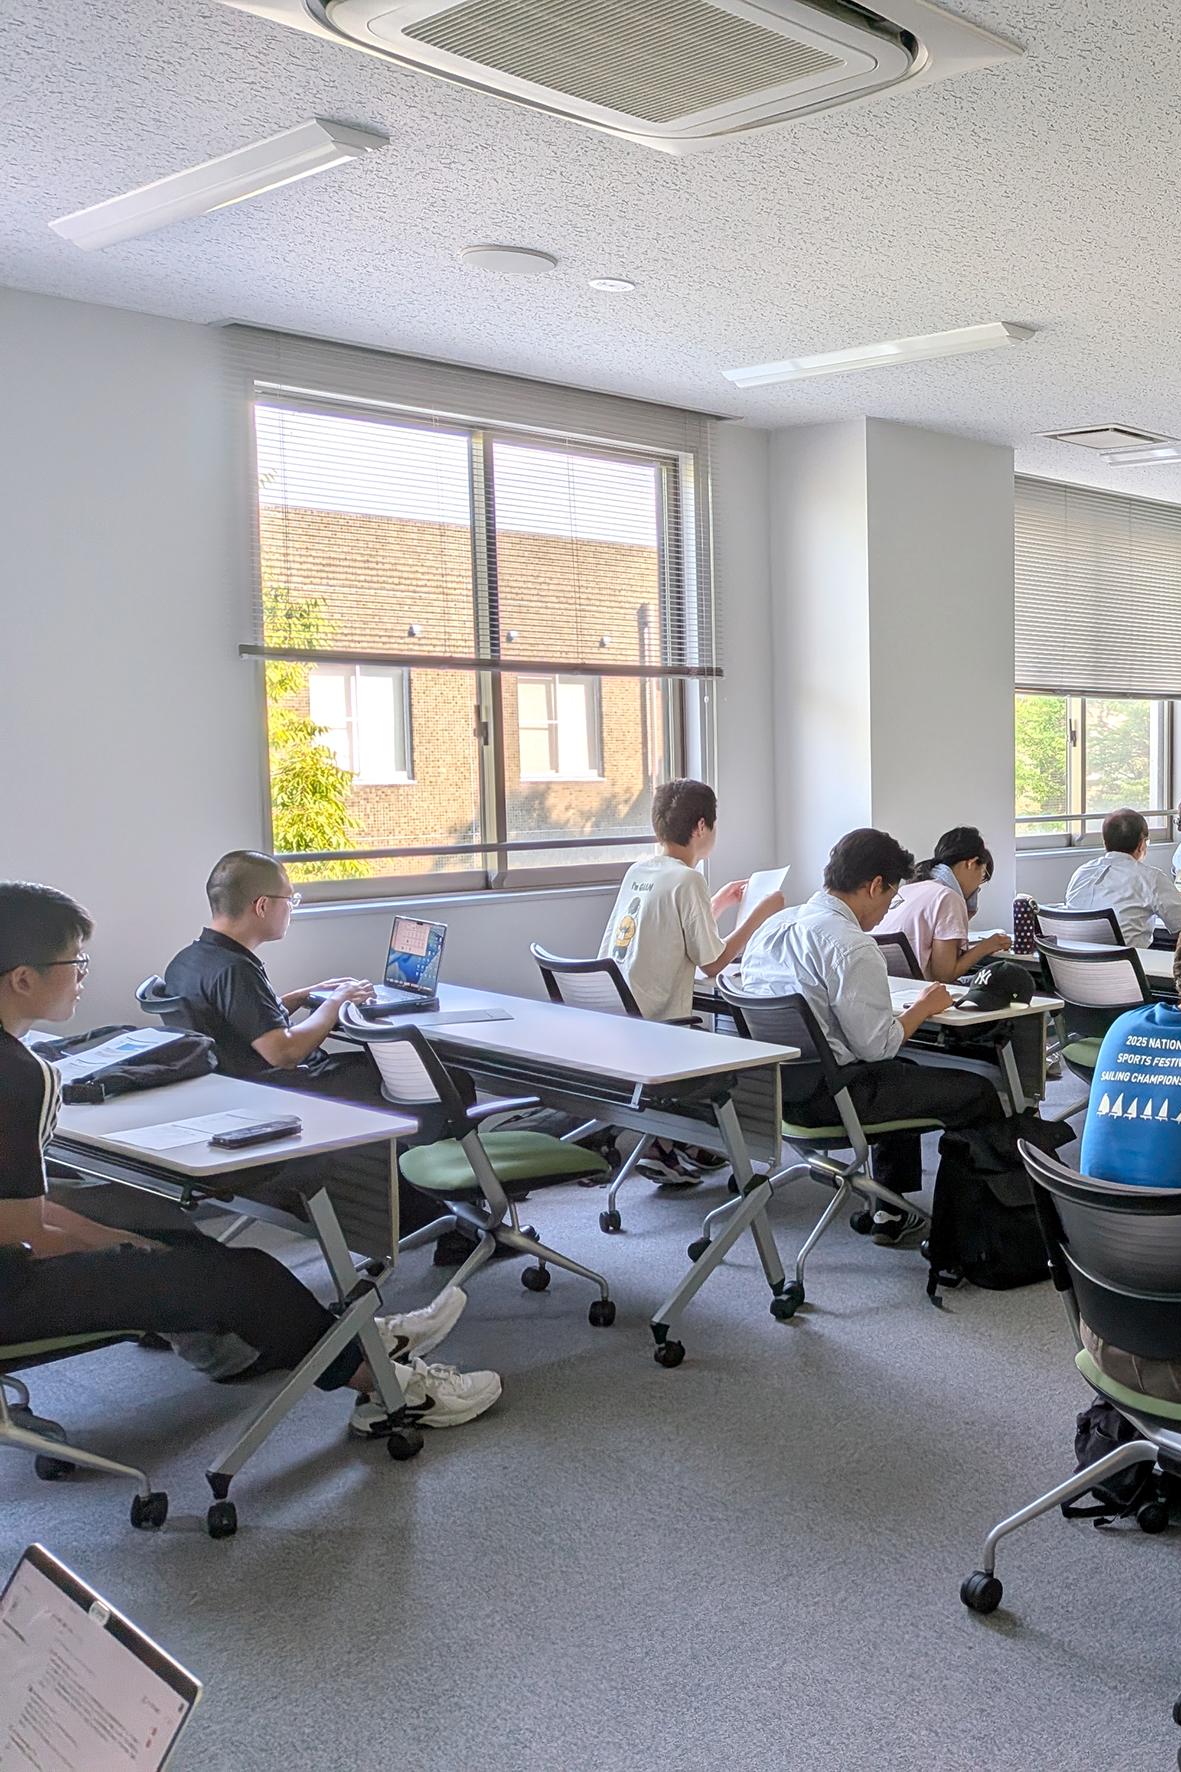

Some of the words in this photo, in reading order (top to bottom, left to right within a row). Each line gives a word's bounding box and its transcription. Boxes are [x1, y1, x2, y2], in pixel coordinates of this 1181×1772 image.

[1126, 1035, 1148, 1047] 2025
[1117, 1053, 1152, 1066] SPORTS
[1100, 1071, 1131, 1082] SAILING
